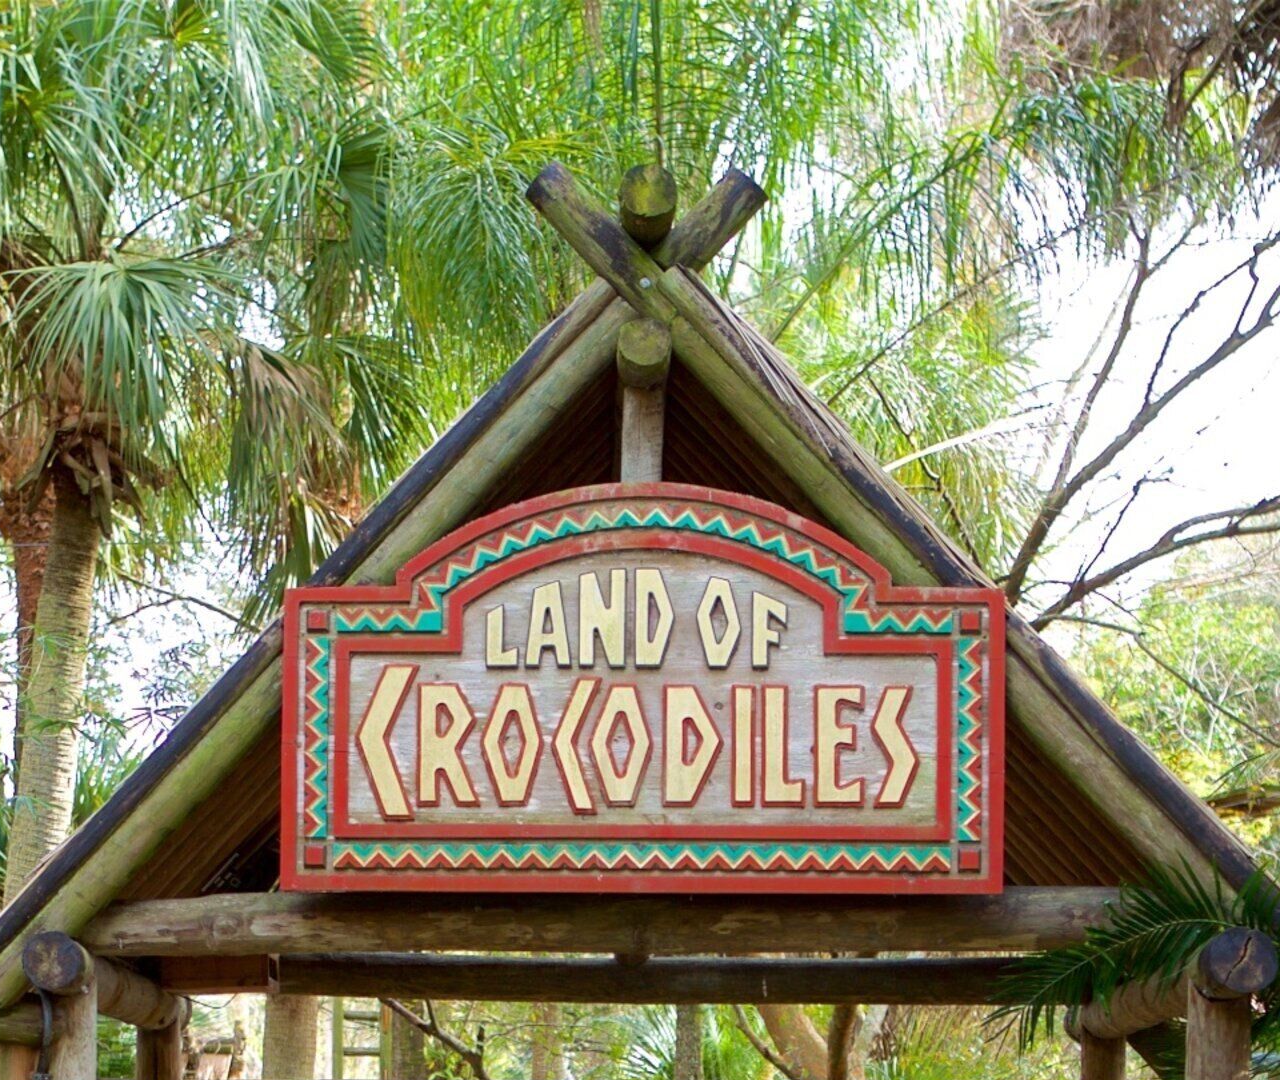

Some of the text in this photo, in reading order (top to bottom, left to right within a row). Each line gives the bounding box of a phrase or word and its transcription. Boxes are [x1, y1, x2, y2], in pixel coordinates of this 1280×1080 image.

[485, 568, 788, 670] LAND OF
[356, 664, 919, 820] CROCODILES
